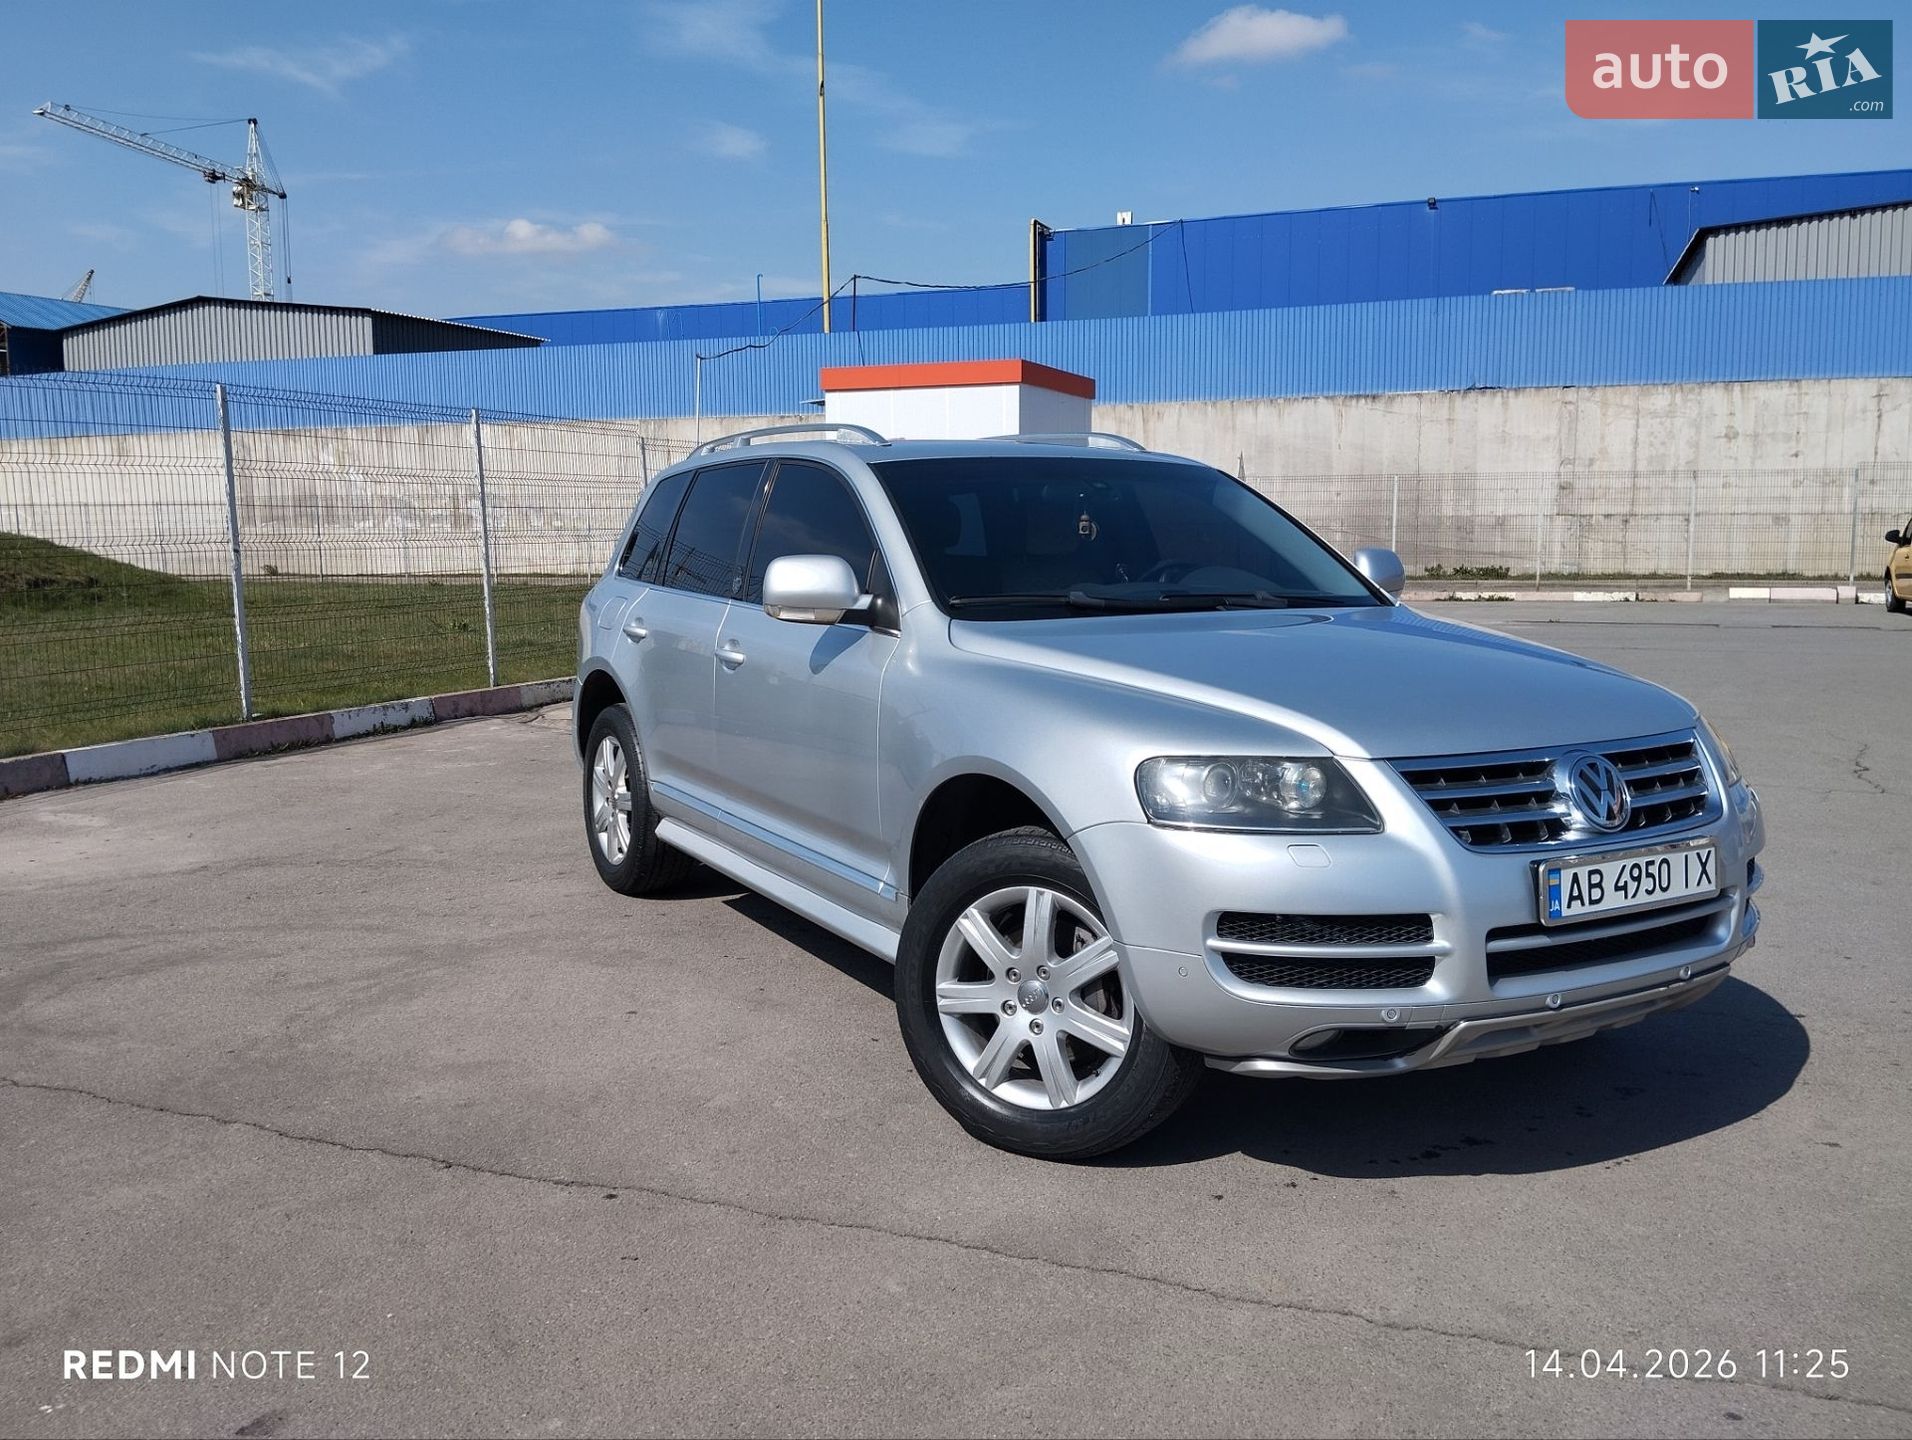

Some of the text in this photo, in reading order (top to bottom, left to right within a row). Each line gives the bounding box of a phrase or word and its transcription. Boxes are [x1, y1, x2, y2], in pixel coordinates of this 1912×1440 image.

[1566, 849, 1713, 909] AB 4950 IX
